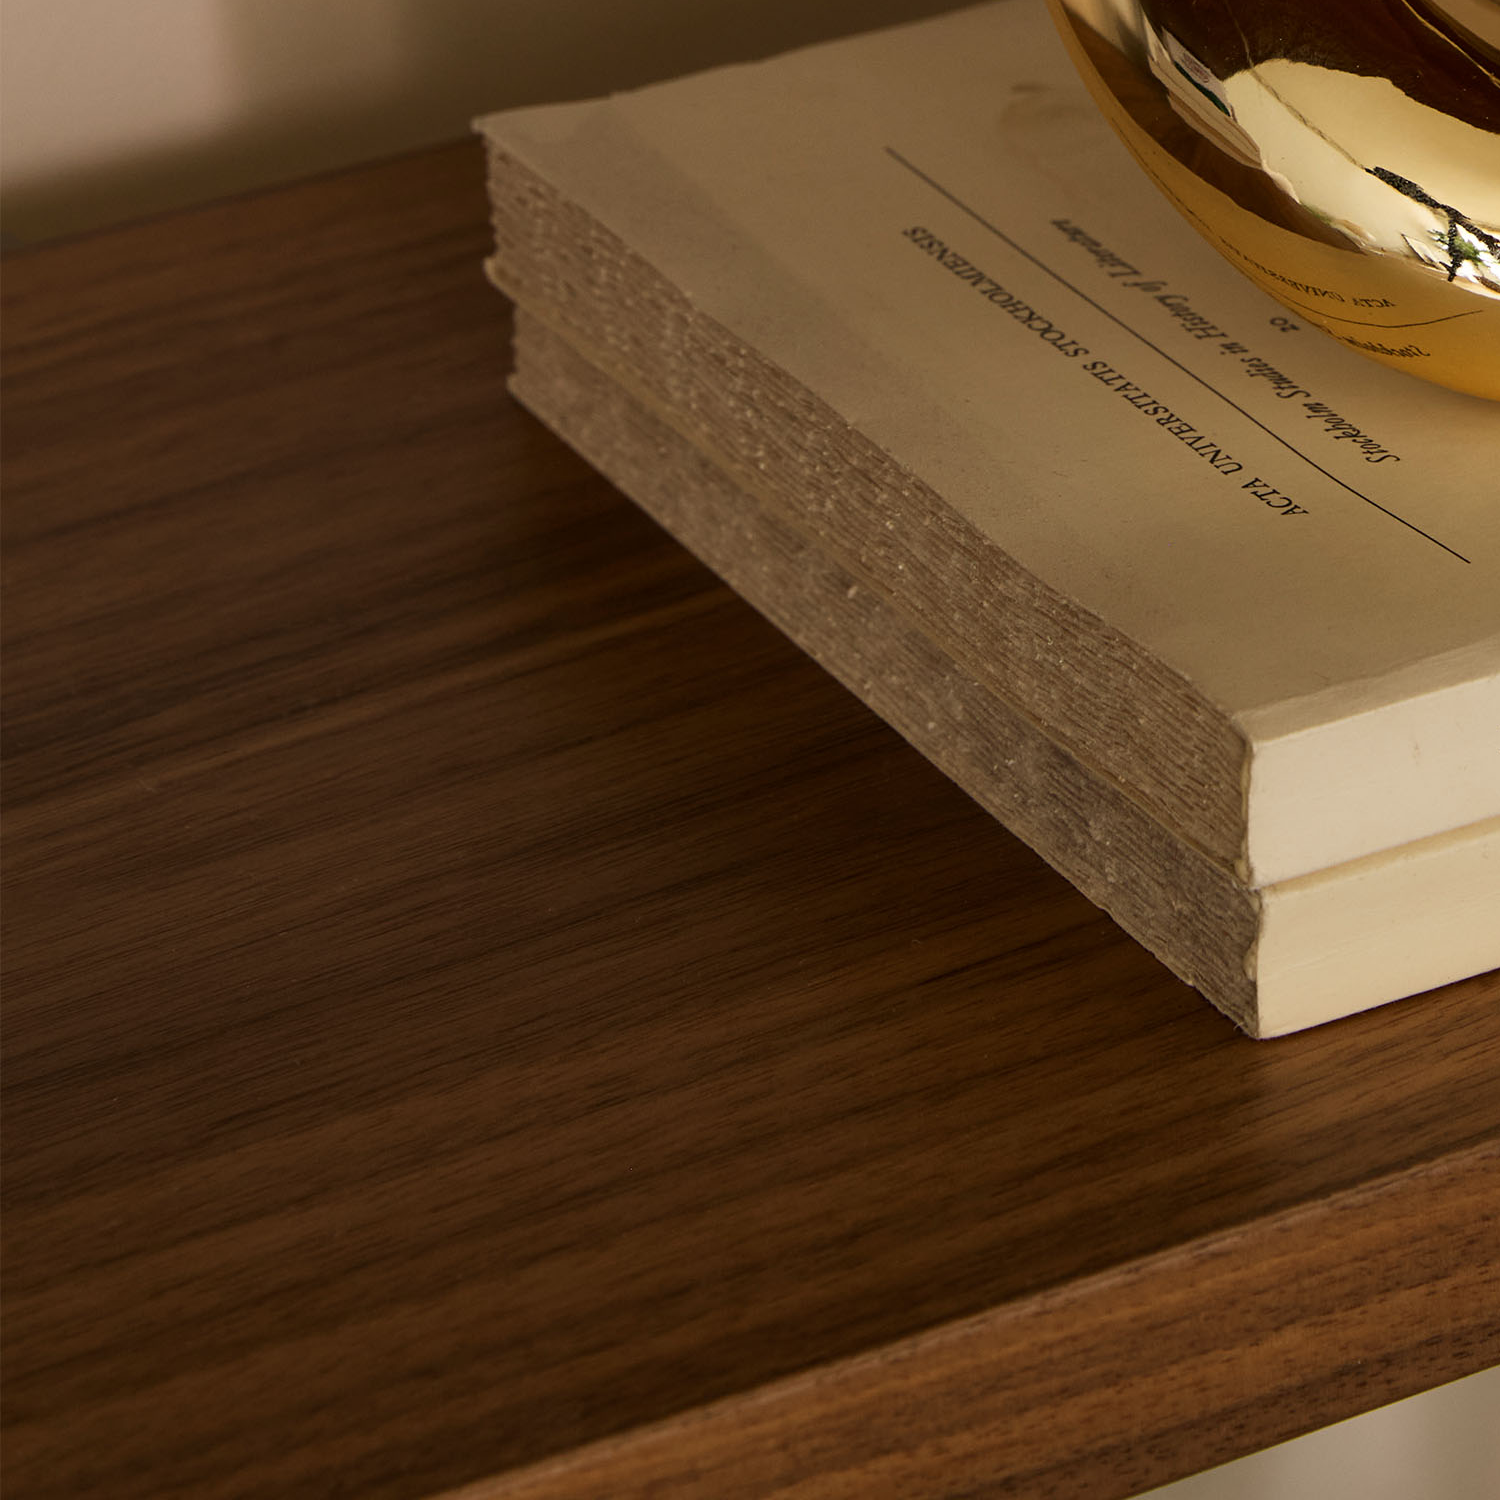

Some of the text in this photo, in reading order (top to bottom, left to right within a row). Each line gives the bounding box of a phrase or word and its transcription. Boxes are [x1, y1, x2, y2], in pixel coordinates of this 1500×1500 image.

[1121, 280, 1159, 293] of
[1154, 294, 1229, 340] History
[1268, 316, 1300, 333] 20
[1219, 341, 1249, 356] in
[902, 225, 1310, 517] ACTA UNIVERSITATIS STOCKHOLMIENSIS
[1240, 357, 1312, 399] Studies
[1302, 401, 1401, 464] Stockholm
